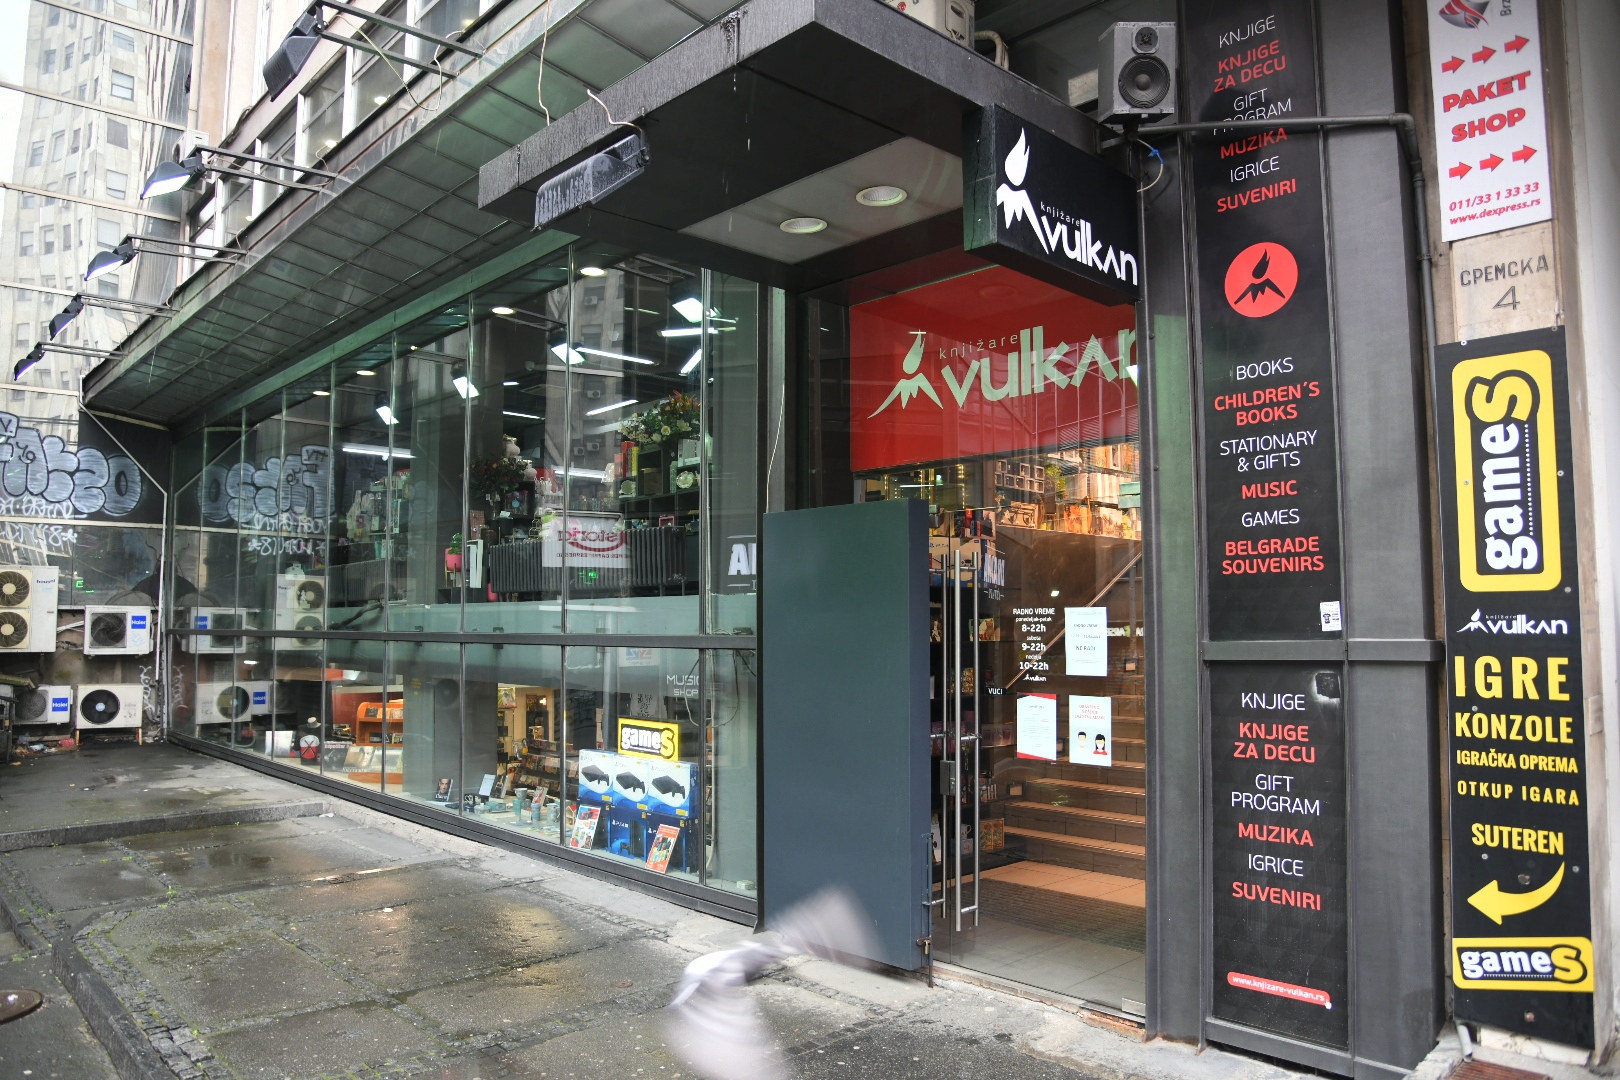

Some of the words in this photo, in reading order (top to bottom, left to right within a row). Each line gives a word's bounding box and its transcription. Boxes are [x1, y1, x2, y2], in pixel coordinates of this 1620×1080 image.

[1219, 15, 1276, 48] KNJIGE
[1218, 40, 1280, 74] KNJIGE
[1214, 75, 1236, 92] ZA
[1241, 55, 1286, 84] DECU
[1233, 88, 1268, 111] GIFT
[1443, 70, 1531, 112] PAKET
[1451, 107, 1526, 142] SHOP
[1220, 128, 1288, 159] MUZIKA
[1230, 156, 1280, 182] IGRICE
[1217, 179, 1297, 212] SUVENIRI
[1449, 193, 1492, 211] 011/33
[1496, 191, 1501, 201] 1
[1505, 186, 1521, 198] 33
[1523, 182, 1539, 194] 33
[1040, 201, 1080, 227] knjižare
[1449, 198, 1541, 225] www.dexpress.rs
[1041, 219, 1138, 286] vulkan
[1460, 254, 1549, 287] СРЕМСКА
[1492, 285, 1521, 311] 4
[939, 333, 1018, 360] knjižare
[1237, 357, 1294, 380] BOOKS
[1214, 381, 1320, 411] CHILDREN'S
[1236, 404, 1298, 426] BOOKS
[1220, 429, 1317, 456] STATIONARY
[1238, 457, 1249, 472] &
[1254, 451, 1301, 470] GIFTS
[1241, 480, 1298, 499] MUSIC
[1241, 508, 1300, 527] GAMES
[1225, 536, 1320, 556] BELGRADE
[1222, 555, 1325, 575] SOUVENIRS
[1022, 624, 1046, 632] 8-22h
[1487, 614, 1568, 634] vulkan
[1020, 662, 1049, 670] 10-22h
[1454, 655, 1570, 701] IGRE
[1241, 692, 1306, 711] KNJIGE
[1239, 722, 1309, 742] KNJIGE
[1455, 712, 1574, 744] KONZOLE
[1233, 742, 1258, 758] ZA
[1264, 744, 1315, 763] DECU
[1456, 748, 1516, 769] IGRAČKA
[1520, 754, 1579, 774] OPREMA
[1255, 774, 1294, 793] GIFT
[1457, 780, 1514, 799] OTKUP
[1522, 785, 1580, 806] IGARA
[1231, 792, 1320, 816] PROGRAM
[1238, 822, 1314, 847] MUZIKA
[1471, 823, 1564, 856] SUTEREN
[1248, 853, 1304, 876] IGRICE
[1232, 881, 1321, 911] SUVENIRI
[1232, 975, 1325, 1002] www.knjizare-vulkan.rs
